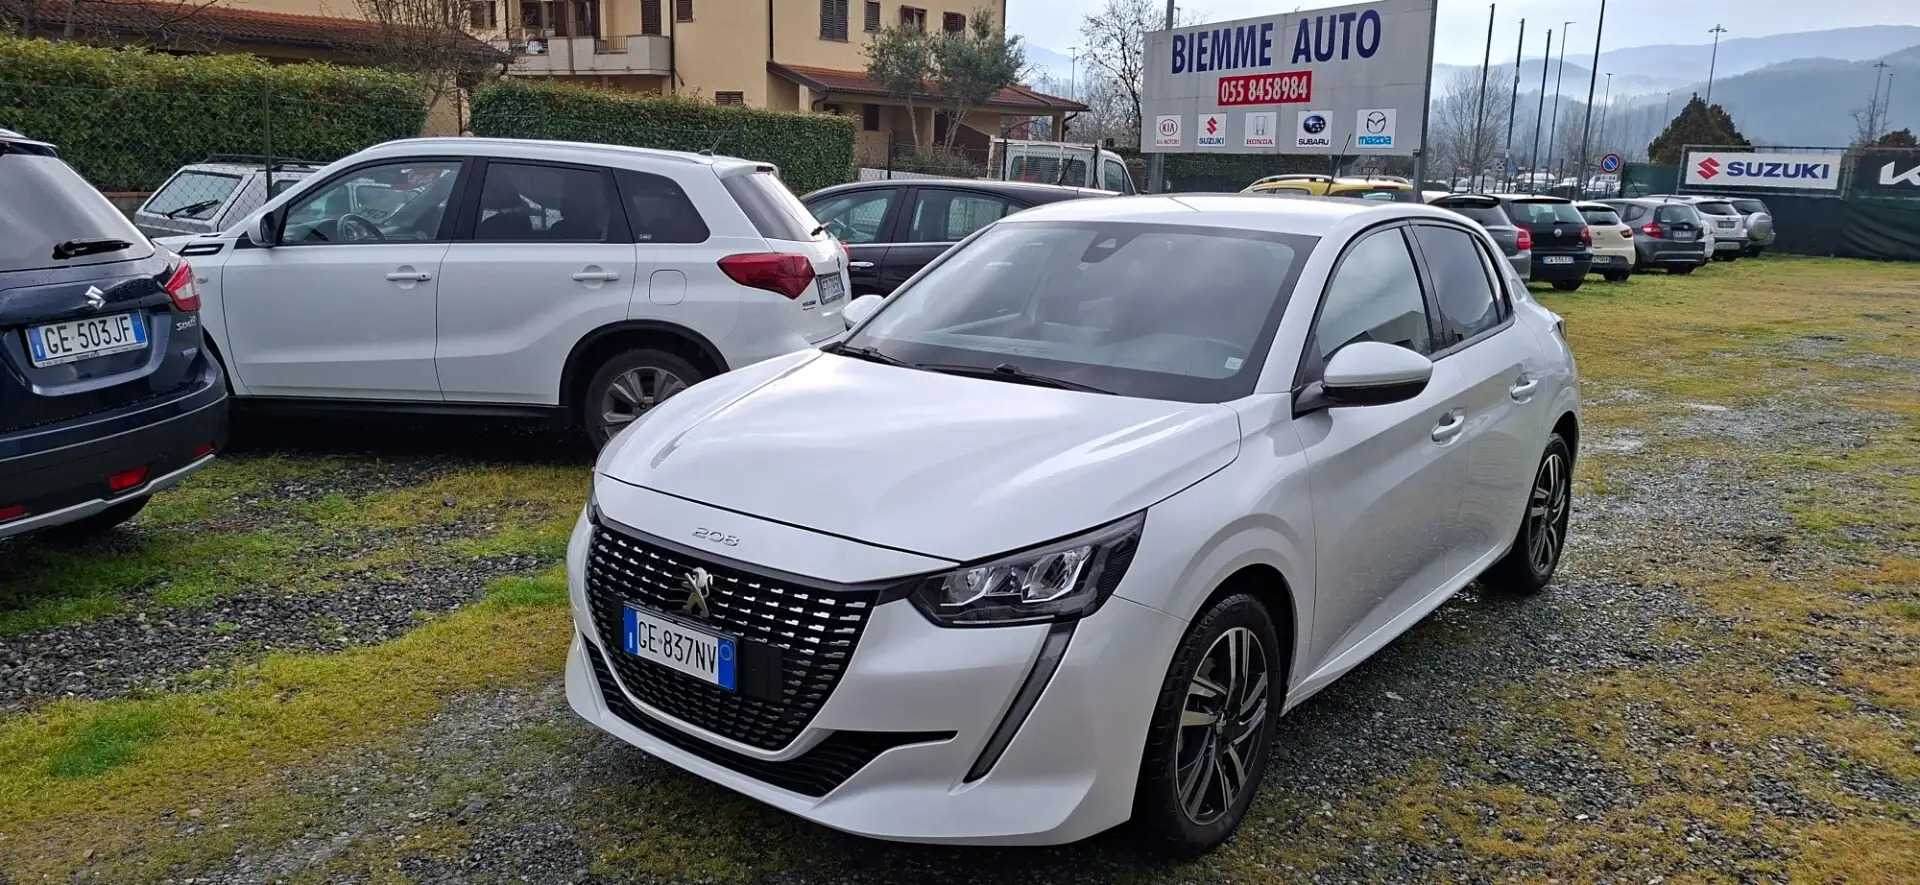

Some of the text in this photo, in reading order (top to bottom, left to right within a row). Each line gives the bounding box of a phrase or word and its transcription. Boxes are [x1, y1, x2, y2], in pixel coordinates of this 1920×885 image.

[1171, 9, 1381, 74] BIEMME AUTO
[1221, 75, 1308, 103] 055 8458984
[1162, 123, 1175, 132] KIA
[1198, 137, 1225, 145] SUZUKI
[1298, 138, 1330, 146] SUBARU
[1726, 161, 1830, 180] SUZUKI
[44, 325, 73, 355] GE
[692, 526, 741, 547] 208
[638, 620, 658, 654] GE
